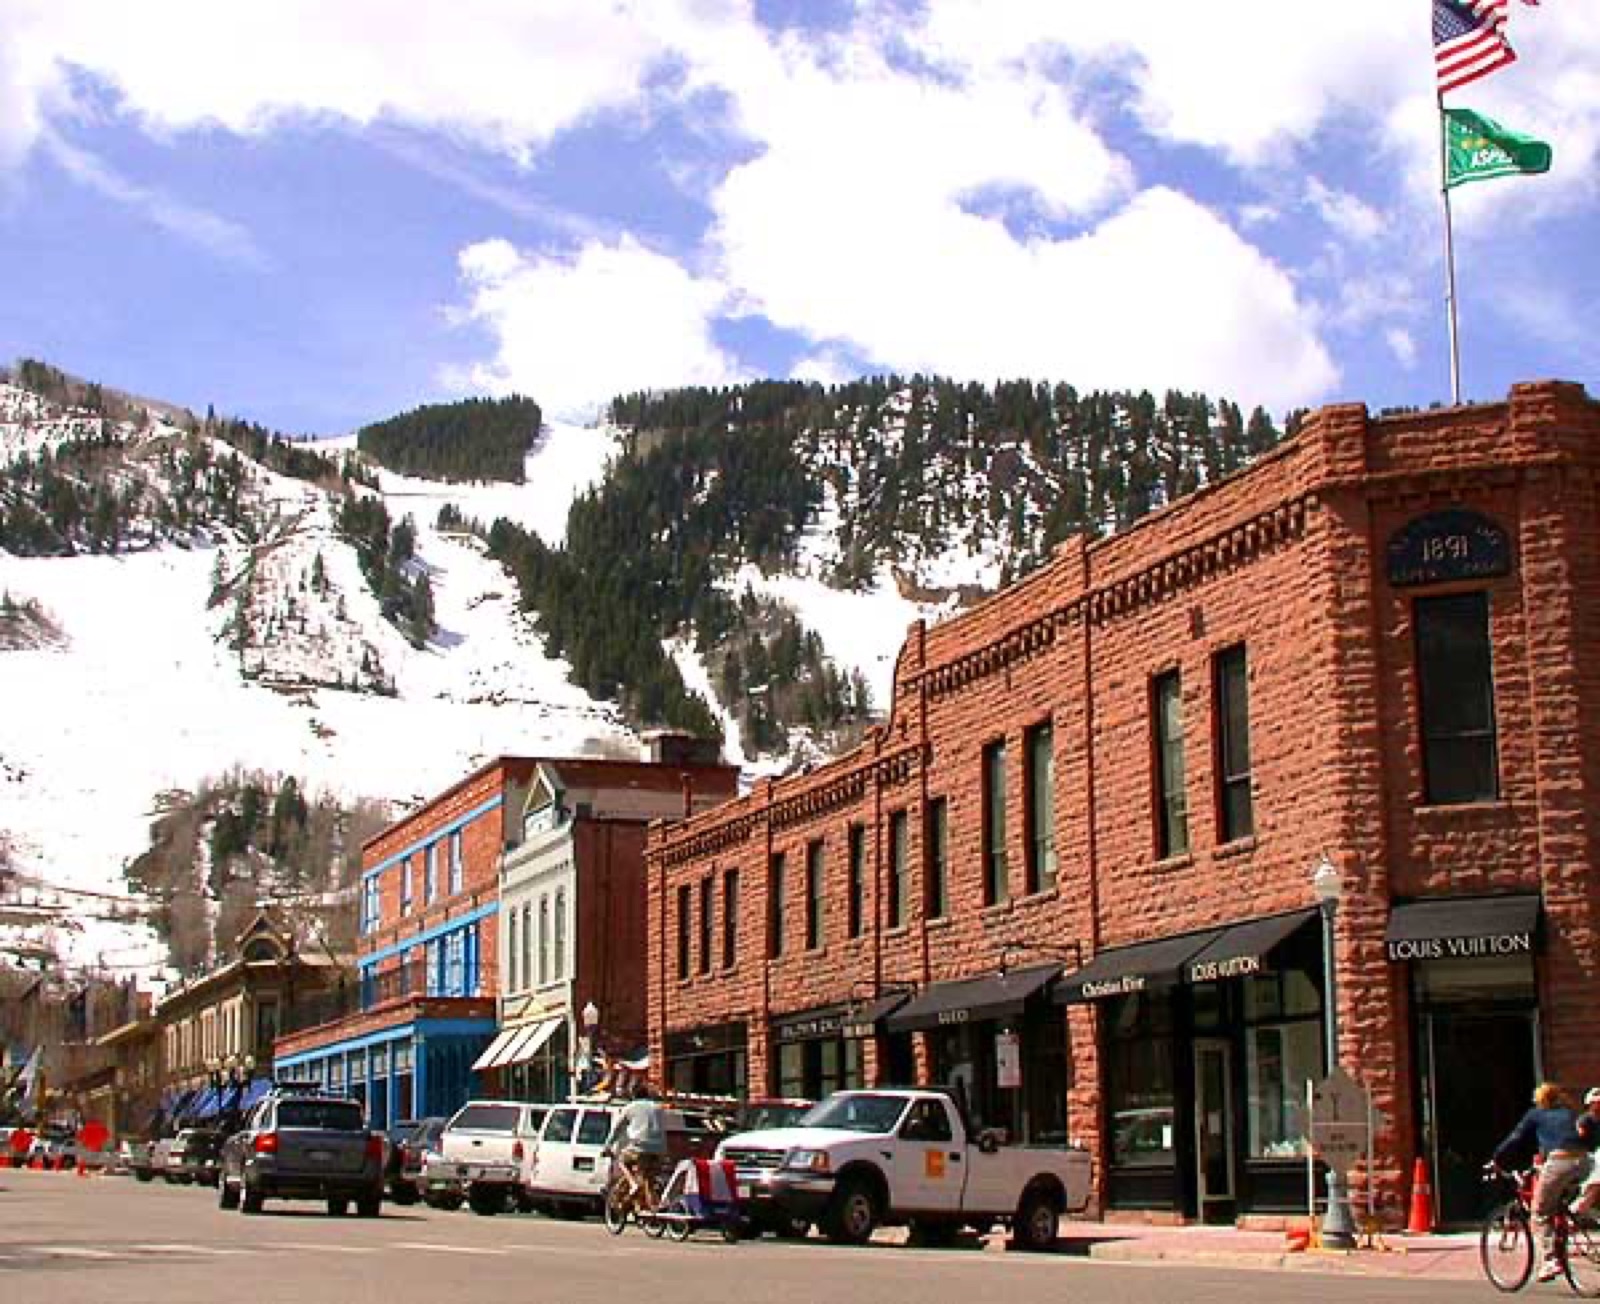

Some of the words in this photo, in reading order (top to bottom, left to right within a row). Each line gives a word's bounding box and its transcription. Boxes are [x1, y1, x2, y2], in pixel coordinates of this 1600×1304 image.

[1423, 535, 1468, 562] 1891
[1389, 938, 1443, 961] LOUIS
[1447, 932, 1530, 957] VUITTON
